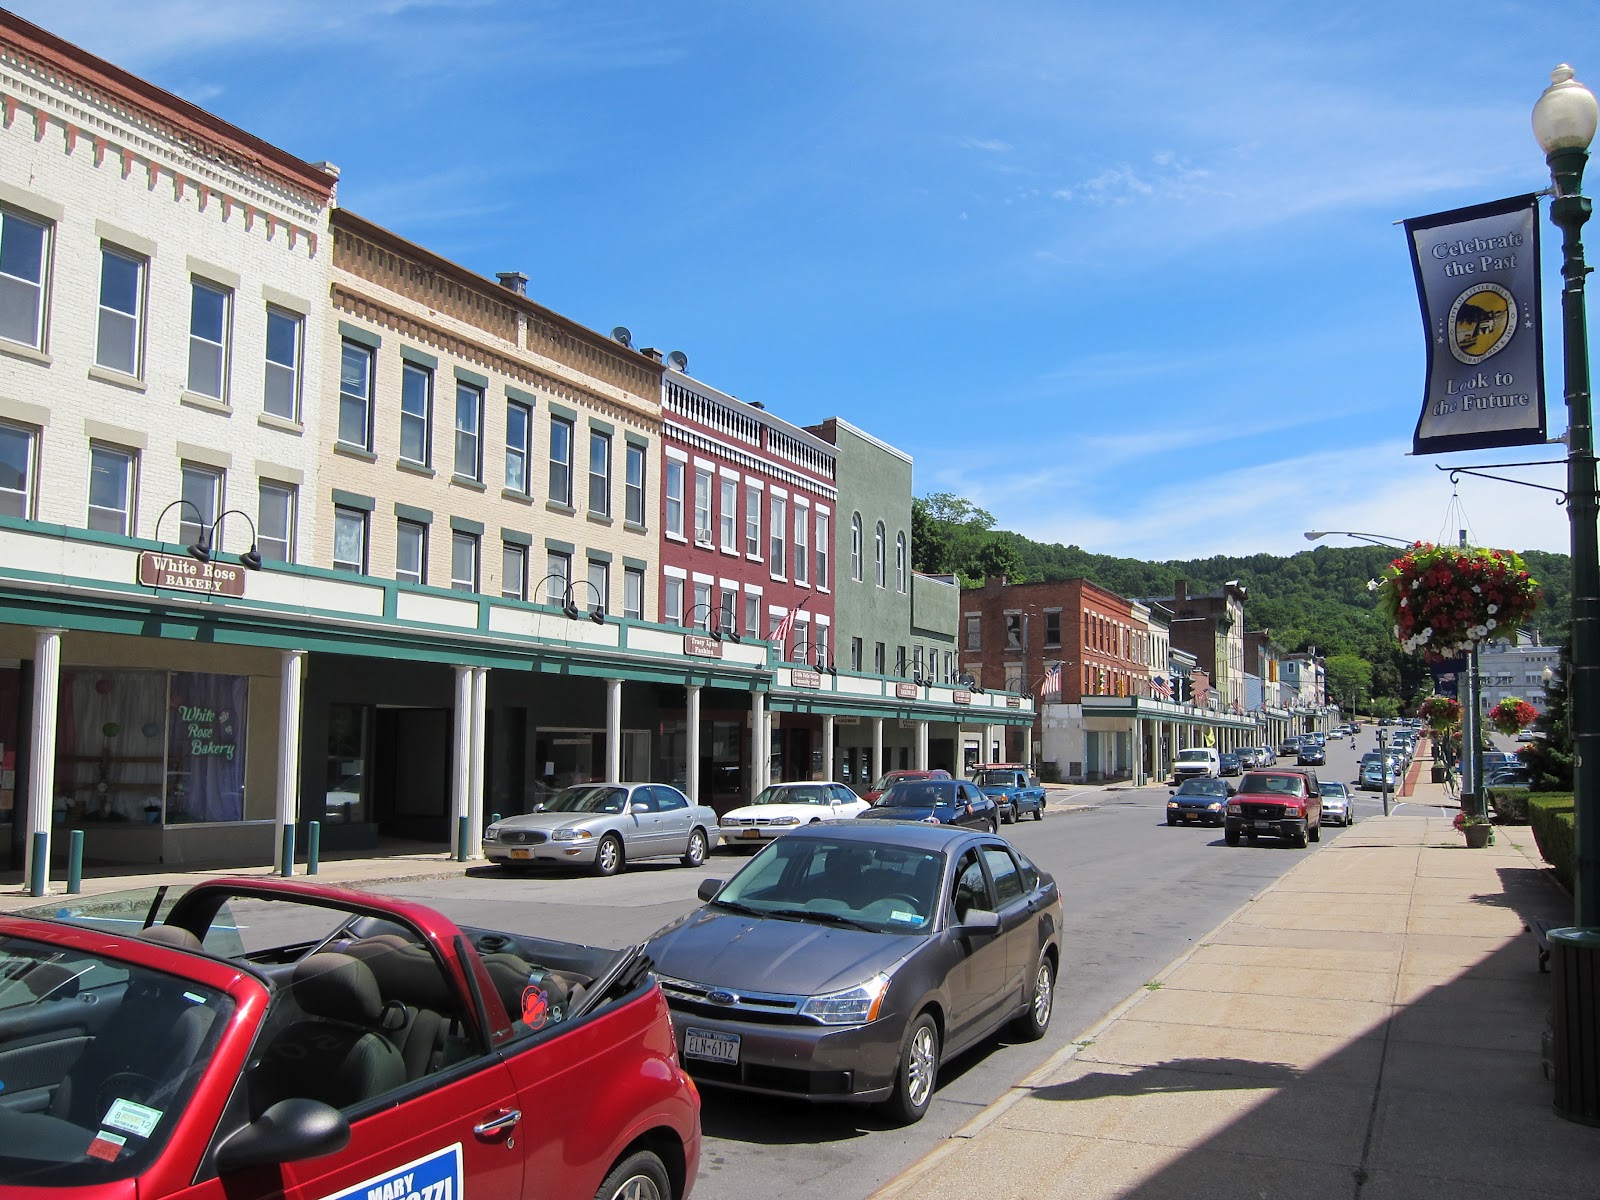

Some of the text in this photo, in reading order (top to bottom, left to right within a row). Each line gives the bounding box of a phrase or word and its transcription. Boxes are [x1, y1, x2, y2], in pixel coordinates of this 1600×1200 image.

[1432, 232, 1523, 259] Celebrate
[1444, 253, 1516, 277] the Past
[1446, 371, 1513, 395] Look to
[1432, 392, 1529, 416] the Future
[152, 556, 236, 580] White Rose
[166, 574, 222, 592] BAKERY
[178, 705, 216, 722] White
[188, 724, 213, 738] Rose
[191, 740, 235, 760] Bakery
[367, 1173, 414, 1200] MARY
